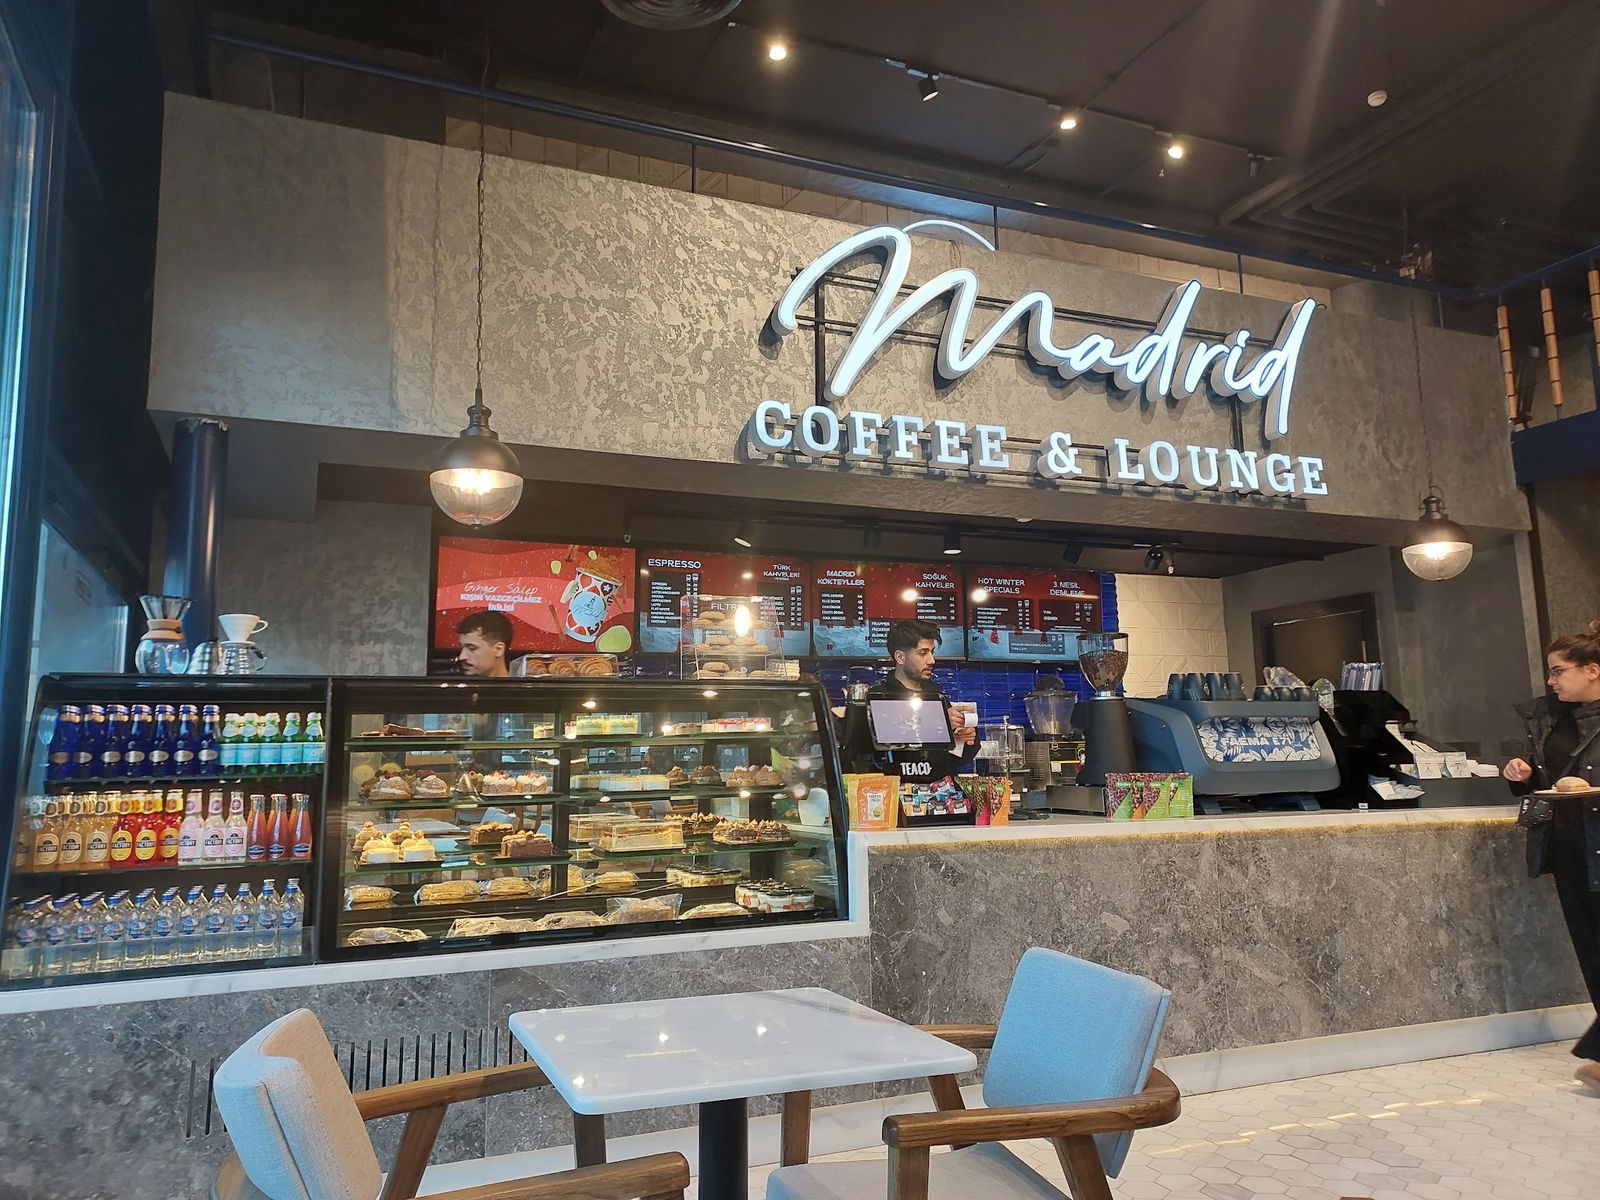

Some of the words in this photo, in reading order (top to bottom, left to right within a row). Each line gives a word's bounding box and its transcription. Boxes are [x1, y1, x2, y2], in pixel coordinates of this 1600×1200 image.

[777, 219, 1316, 437] Madrid
[755, 401, 1009, 469] COFFEE
[1047, 431, 1082, 476] &
[1112, 437, 1329, 496] LOUNGE
[648, 558, 702, 569] ESPRESSO
[826, 570, 856, 578] MADRID
[817, 578, 866, 586] KOKTEYLLER
[915, 581, 956, 589] KAHVELER
[977, 577, 994, 585] HOT
[464, 582, 500, 596] Ginger
[984, 586, 1020, 594] SPECIALS
[711, 602, 743, 611] FILTR
[1220, 737, 1269, 746] FAEMA
[900, 762, 932, 776] TEACO
